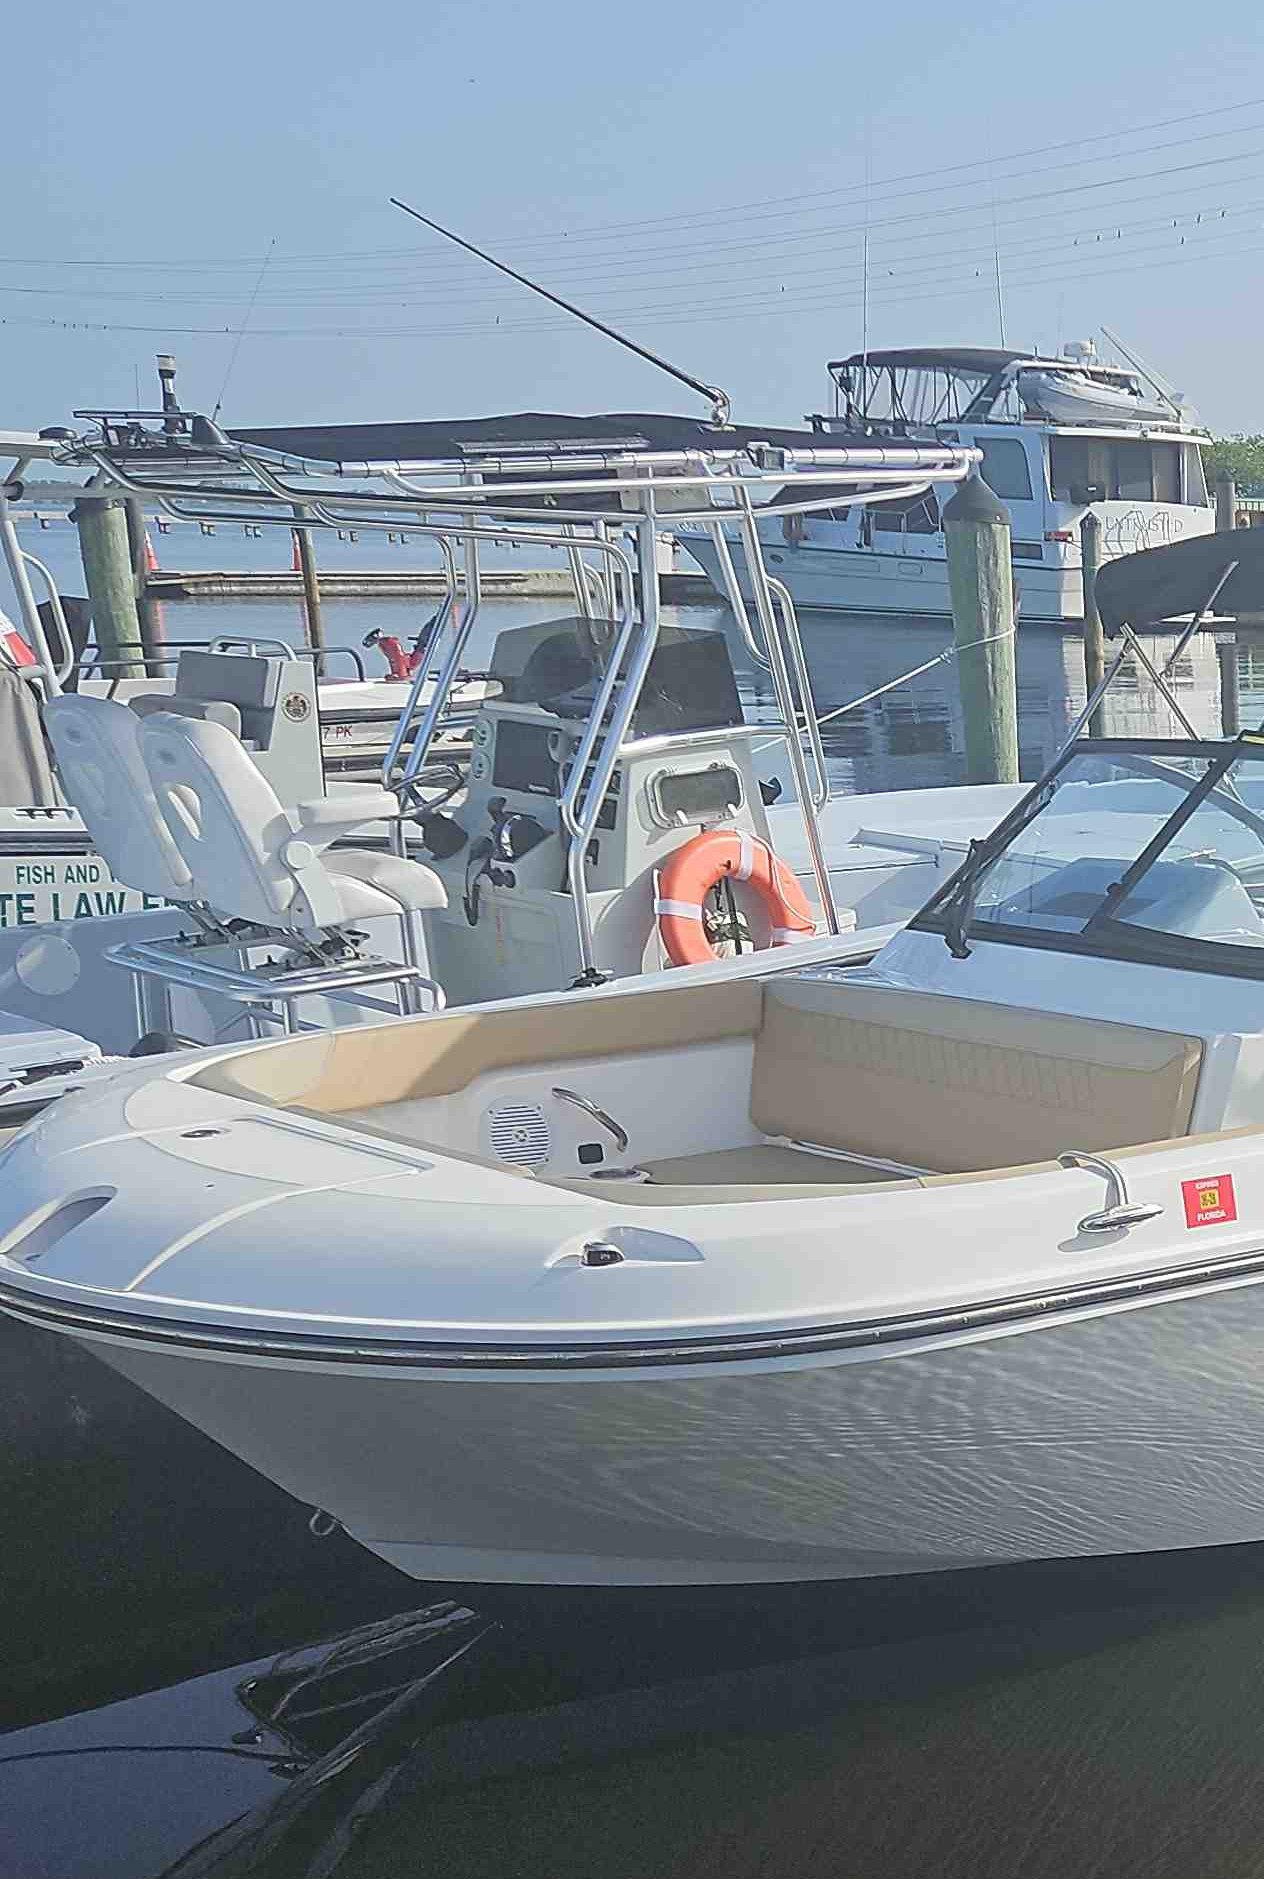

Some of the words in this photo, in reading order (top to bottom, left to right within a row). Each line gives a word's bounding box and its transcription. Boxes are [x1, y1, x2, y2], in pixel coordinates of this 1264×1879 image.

[335, 725, 353, 739] PK
[16, 865, 56, 885] FISH
[64, 864, 101, 884] AND
[52, 891, 127, 922] LAW
